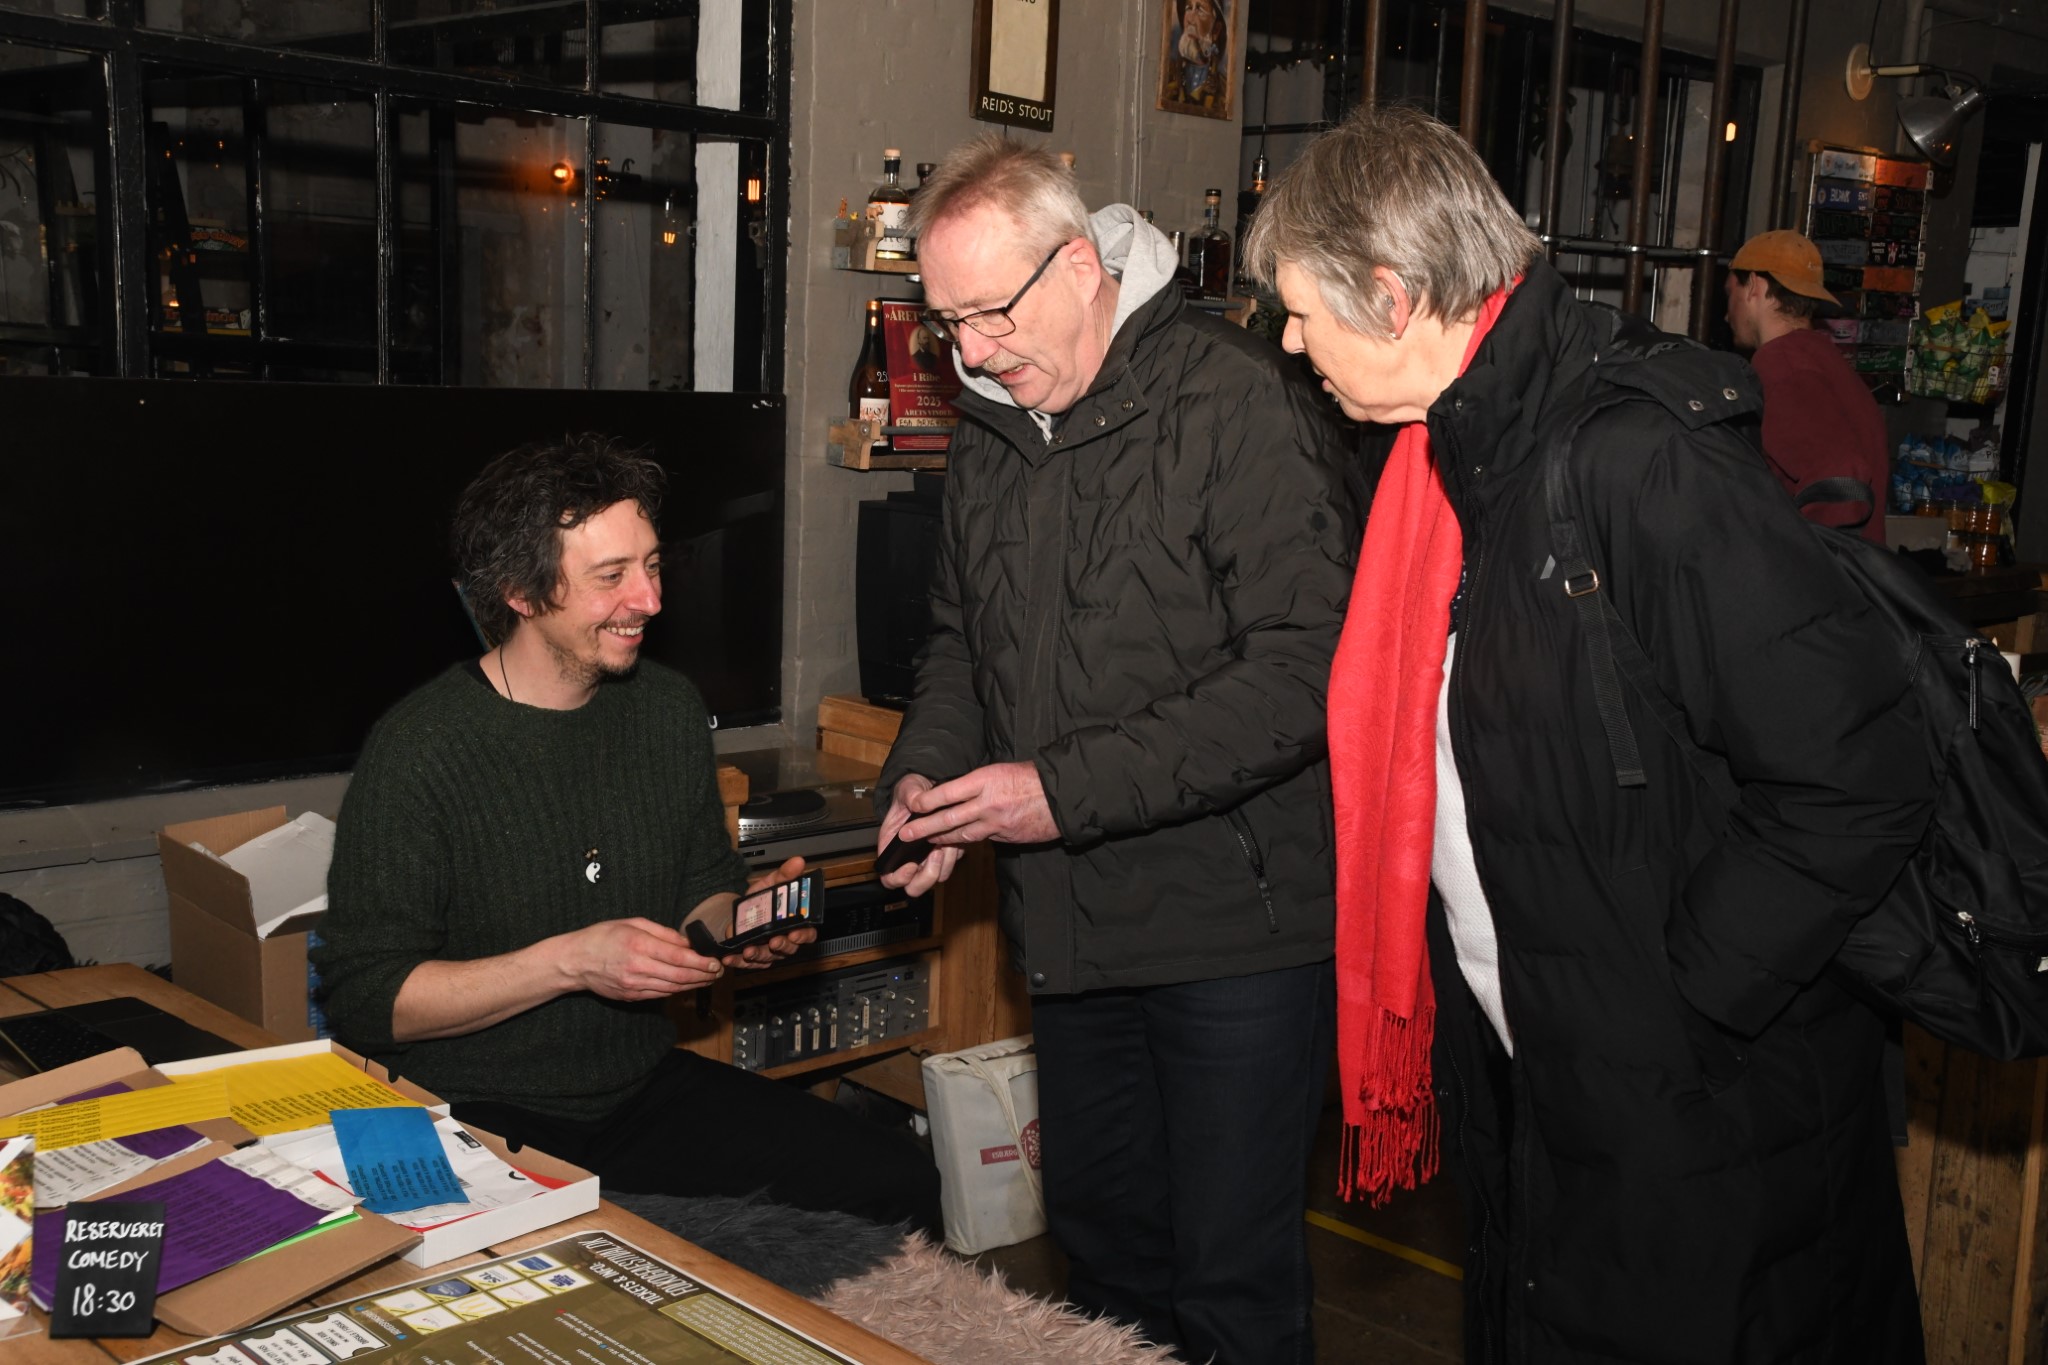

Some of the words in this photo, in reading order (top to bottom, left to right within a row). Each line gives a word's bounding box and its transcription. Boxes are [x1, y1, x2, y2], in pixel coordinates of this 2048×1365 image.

[982, 96, 1014, 115] REID'S
[1018, 104, 1052, 121] STOUT
[917, 396, 942, 407] 2025
[64, 1220, 165, 1243] RESERVERET
[68, 1250, 149, 1272] COMEDY
[588, 1262, 619, 1279] INFO:
[72, 1282, 136, 1316] 18:30
[621, 1279, 664, 1305] TICKETS
